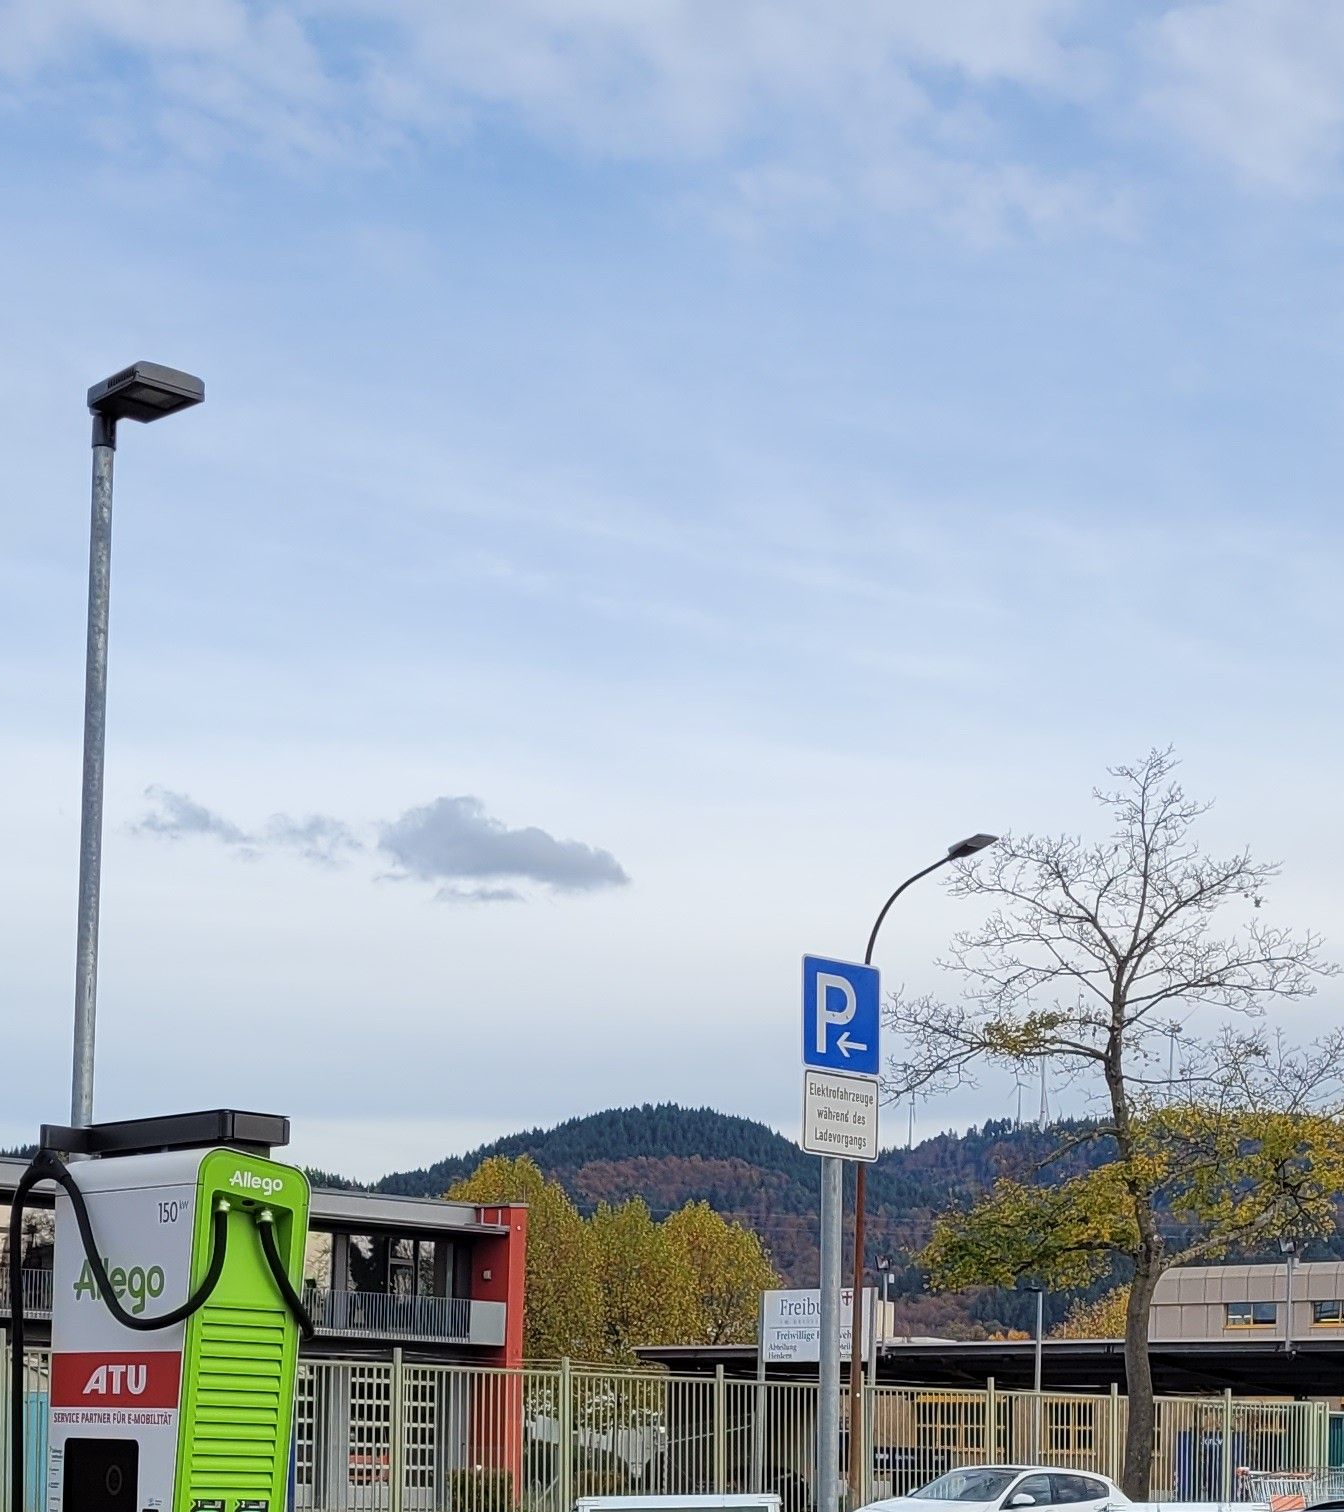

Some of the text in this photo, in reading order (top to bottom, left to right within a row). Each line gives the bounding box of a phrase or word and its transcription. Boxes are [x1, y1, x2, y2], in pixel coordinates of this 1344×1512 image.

[816, 971, 857, 1054] P
[809, 1081, 874, 1108] Elektrofahrzeuge
[816, 1105, 866, 1126] während des
[814, 1126, 867, 1150] Ladevorgangs
[229, 1169, 284, 1196] Allego
[157, 1201, 178, 1224] 150
[82, 1364, 147, 1395] ATU
[53, 1410, 173, 1426] SERVICE PARTNER FÜR E-MOBILITÄT
